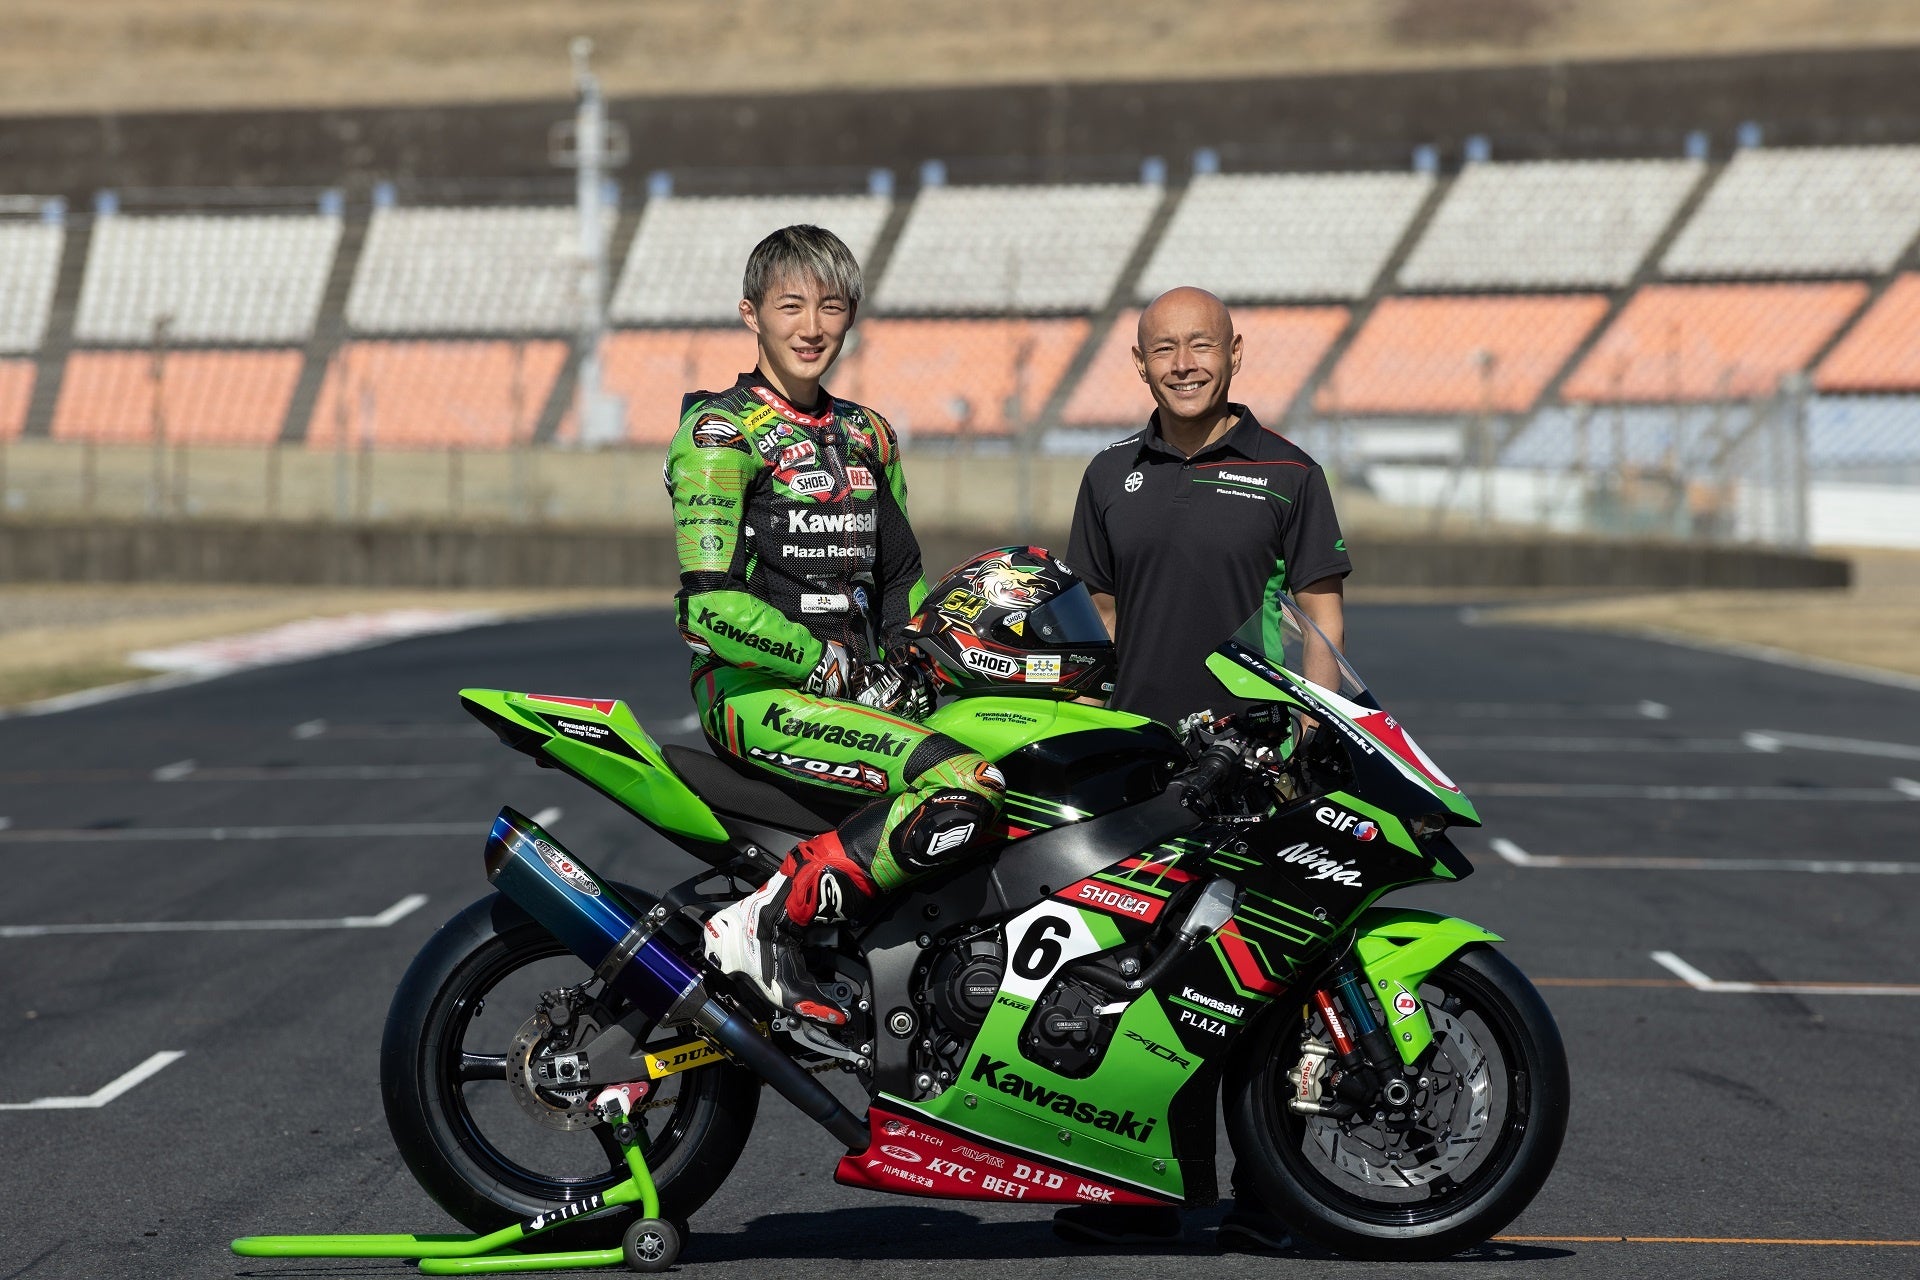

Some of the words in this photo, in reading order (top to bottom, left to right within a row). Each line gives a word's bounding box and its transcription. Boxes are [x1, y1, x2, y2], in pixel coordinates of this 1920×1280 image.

[797, 476, 828, 490] SHOEI
[851, 470, 872, 485] BEE
[1218, 470, 1268, 486] Kawasaki
[1232, 490, 1251, 498] Racing
[788, 509, 878, 533] Kawasak
[782, 545, 825, 557] Plaza
[827, 544, 866, 558] Racing
[697, 606, 805, 665] Kawasaki
[969, 651, 1012, 674] SHOEI
[557, 720, 589, 732] Kawasaki
[589, 725, 609, 736] Plaza
[760, 702, 912, 758] Kawasaki
[1008, 717, 1027, 725] Team
[1012, 713, 1037, 723] Plaza
[1290, 685, 1376, 755] Kawasaki
[564, 727, 585, 737] Racing
[585, 731, 601, 739] Team
[750, 747, 861, 780] HYOD
[1277, 842, 1363, 888] Ninja
[1011, 915, 1071, 980] 6
[1182, 986, 1245, 1017] Kawasaki
[1180, 1010, 1227, 1037] PLAZA
[1324, 1006, 1345, 1039] SHOWA
[673, 1046, 718, 1066] DUN
[1301, 1061, 1313, 1096] brembo
[970, 1053, 1157, 1144] Kawasaki
[907, 1130, 944, 1147] A-TECH
[882, 1164, 935, 1188] 川内観光交通
[926, 1157, 977, 1183] KTC
[981, 1174, 1029, 1199] BEET
[1077, 1182, 1115, 1202] NGK
